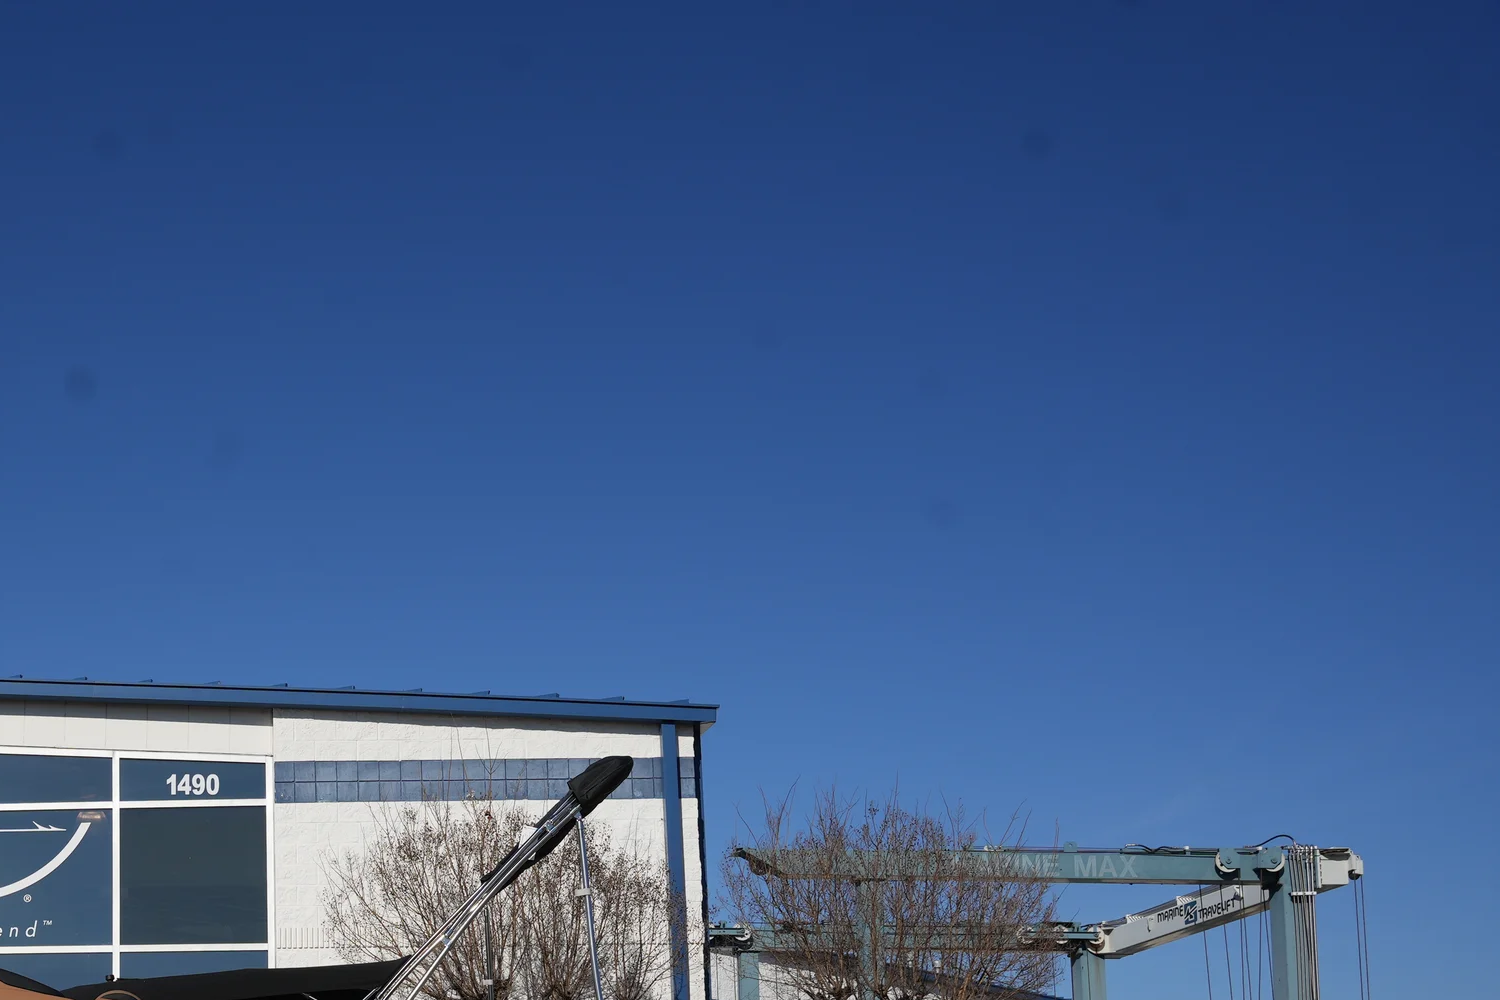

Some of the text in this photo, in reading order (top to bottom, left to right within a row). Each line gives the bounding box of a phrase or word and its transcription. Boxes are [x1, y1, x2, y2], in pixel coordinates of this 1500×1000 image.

[166, 773, 220, 796] 1490
[1074, 854, 1138, 878] MAX
[1157, 898, 1236, 923] MARINE TRAVELIFT
